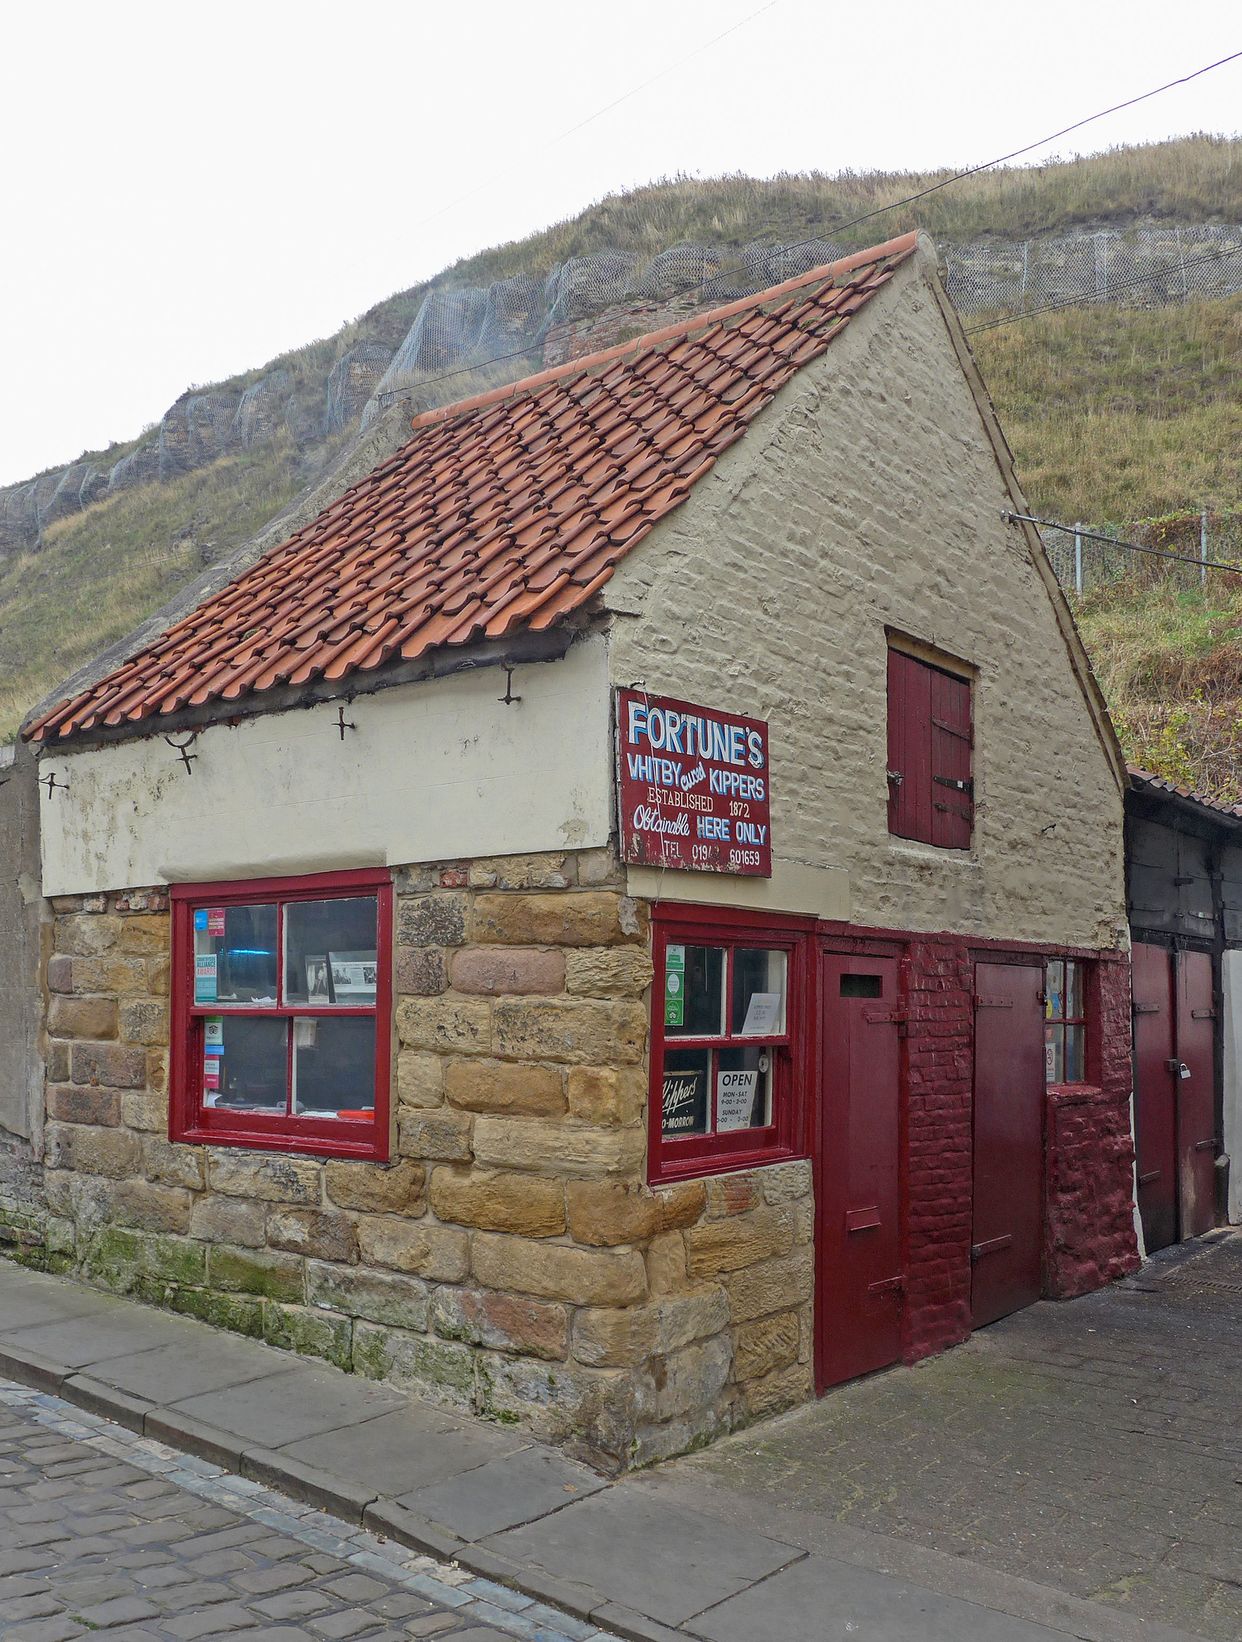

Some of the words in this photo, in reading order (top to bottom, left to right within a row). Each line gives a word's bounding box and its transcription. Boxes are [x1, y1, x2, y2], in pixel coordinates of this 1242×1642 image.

[627, 700, 764, 769] FORTUNE'S
[626, 752, 683, 787] WHITBY
[709, 767, 765, 801] KIPPERS
[647, 786, 714, 813] ESTABLISHED
[729, 800, 750, 818] 1872
[633, 804, 691, 837] Obtainable
[697, 815, 731, 841] HERE
[736, 822, 766, 846] ONLY
[730, 848, 760, 867] 601659
[722, 1073, 752, 1087] OPEN
[662, 1116, 695, 1129] O-MORROW
